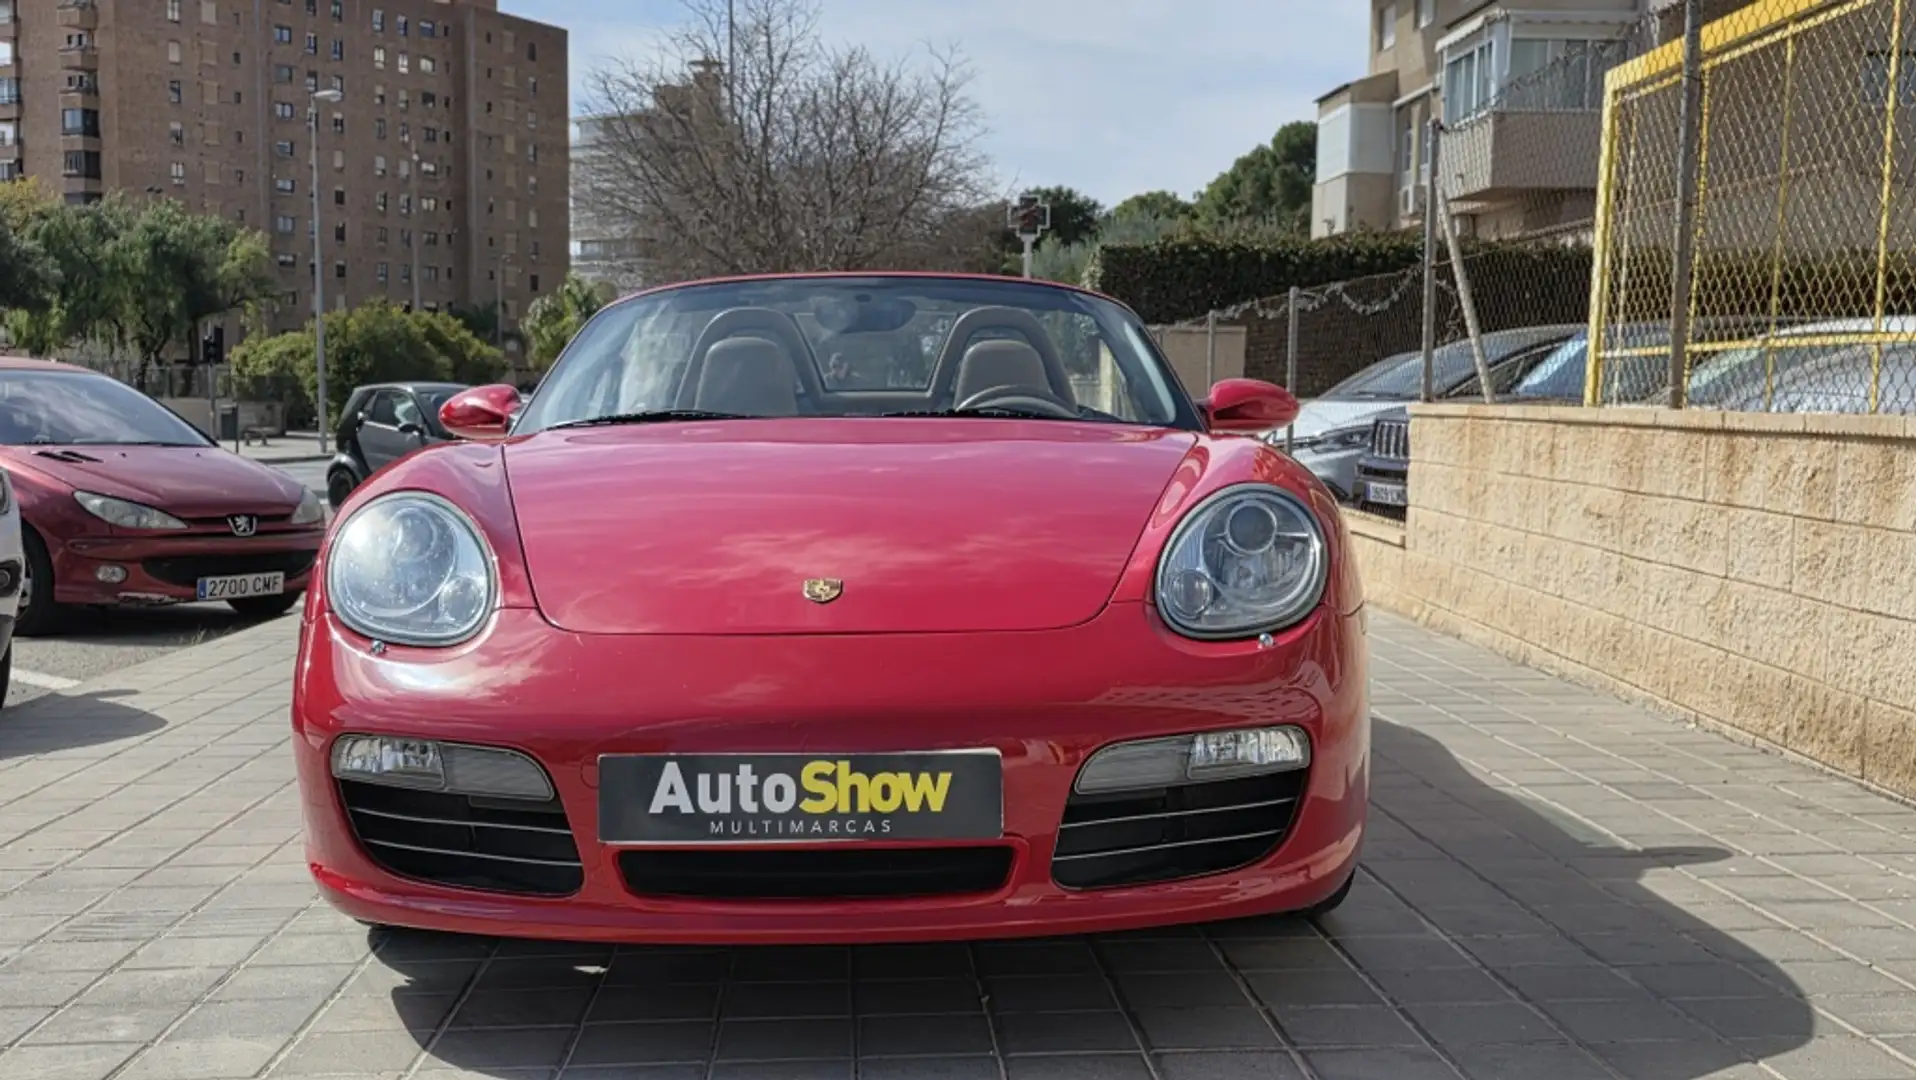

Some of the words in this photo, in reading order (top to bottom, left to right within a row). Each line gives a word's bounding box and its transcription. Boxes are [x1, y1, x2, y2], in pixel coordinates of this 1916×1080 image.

[209, 578, 249, 597] 2700
[648, 760, 952, 814] AutoShow
[709, 819, 892, 835] MULTIMARCAS
